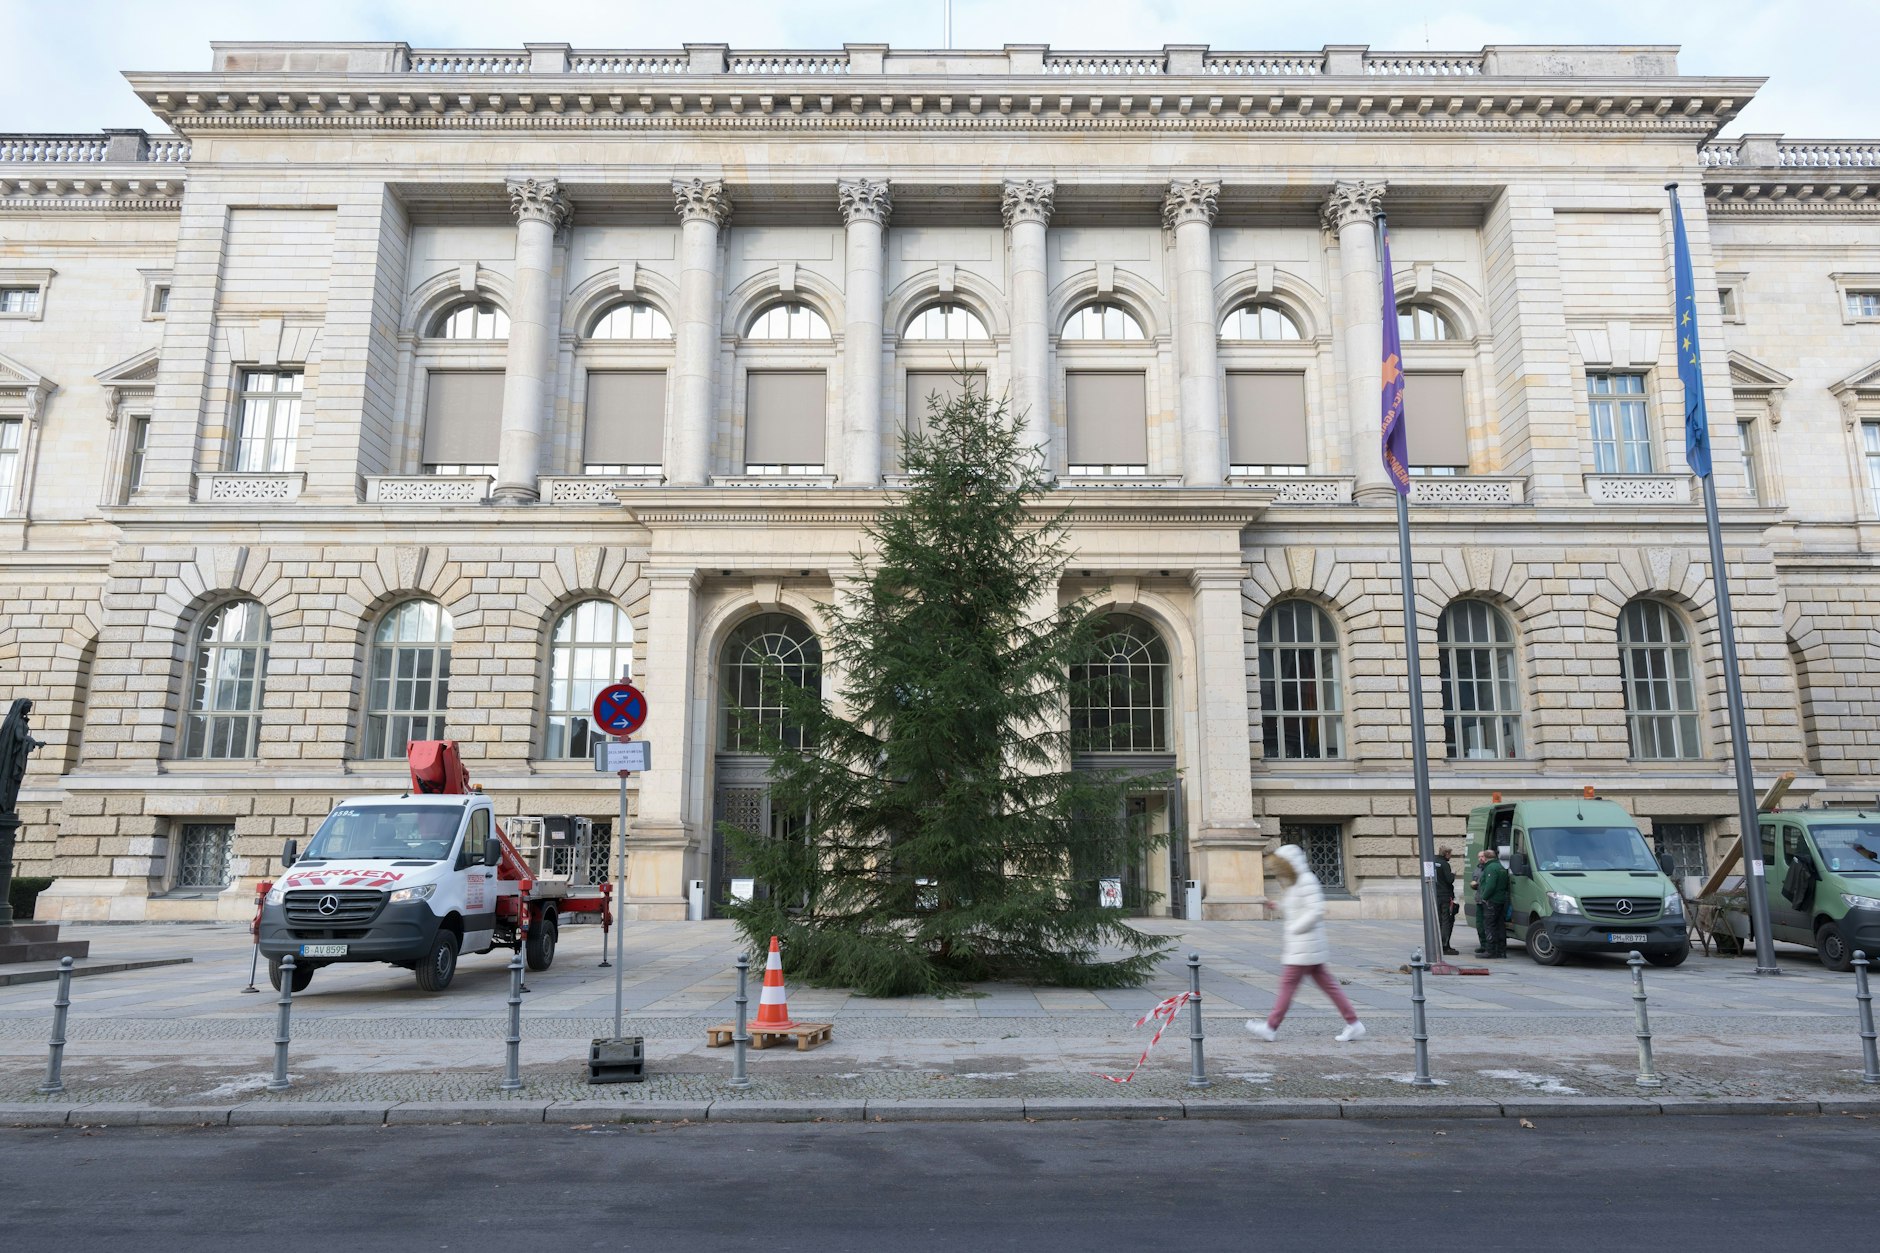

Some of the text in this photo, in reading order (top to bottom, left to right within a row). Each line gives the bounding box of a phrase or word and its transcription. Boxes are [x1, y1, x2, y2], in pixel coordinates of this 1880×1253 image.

[287, 869, 404, 881] GERKEN
[304, 945, 346, 954] B AV 8595
